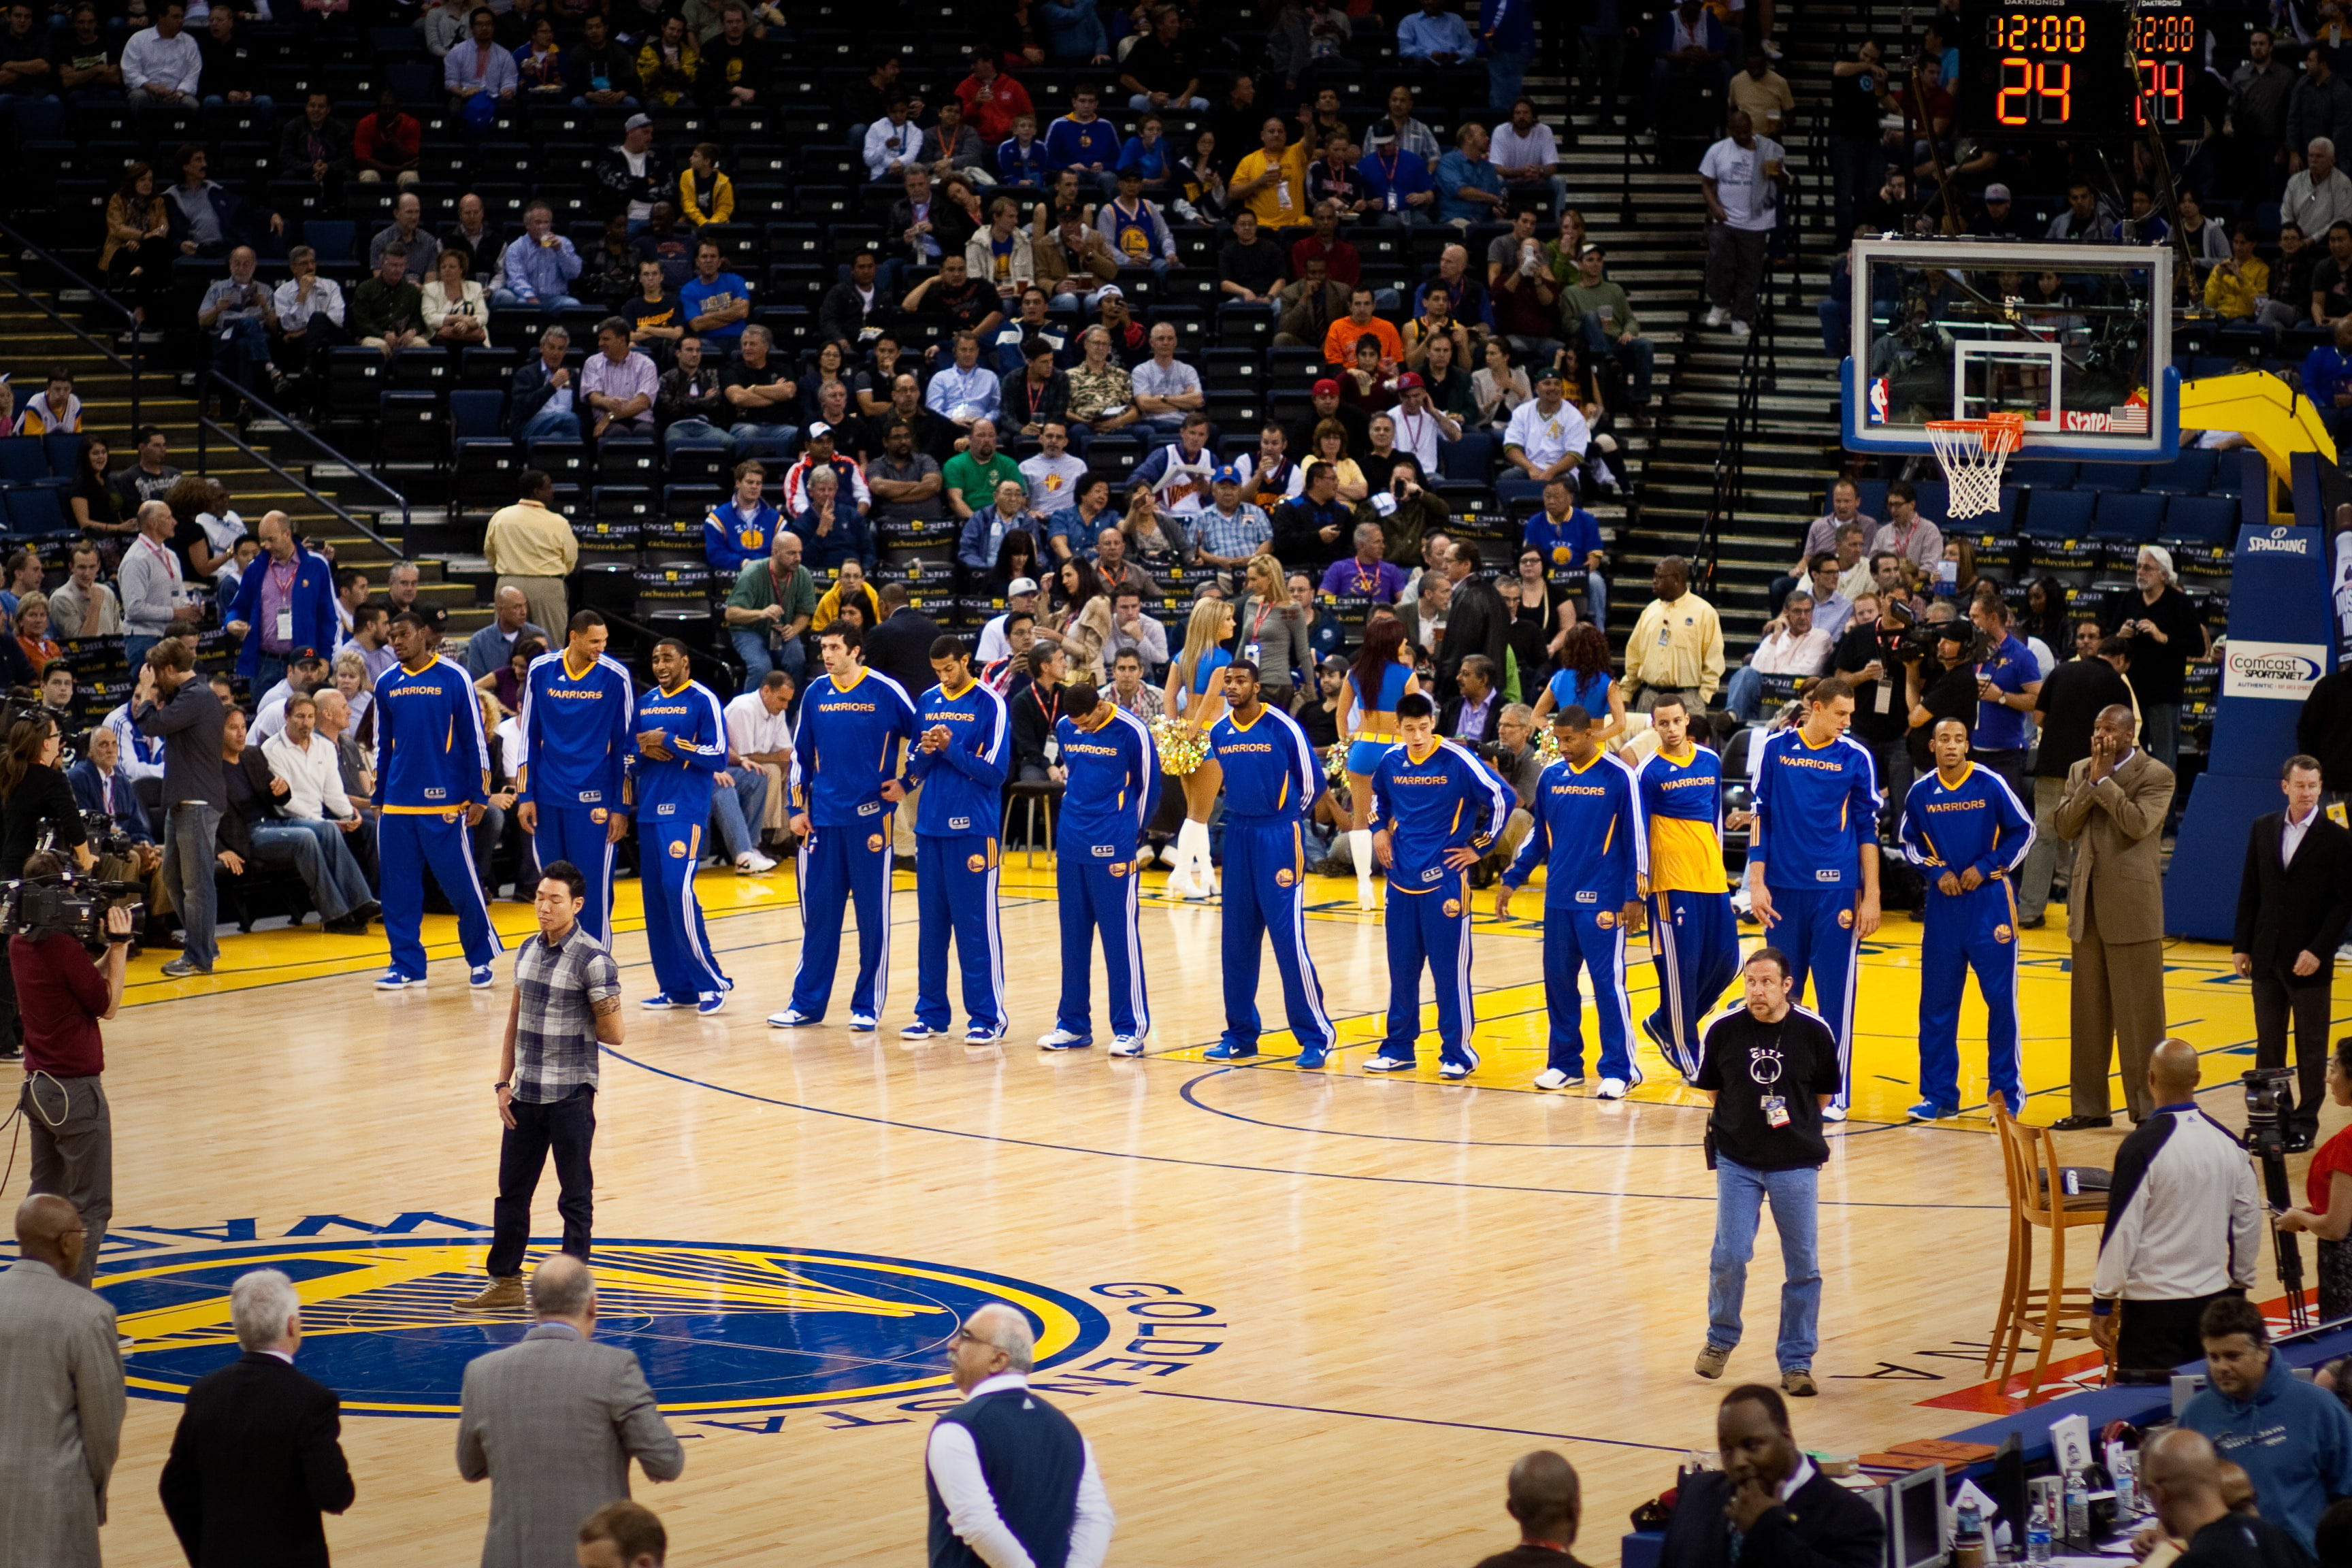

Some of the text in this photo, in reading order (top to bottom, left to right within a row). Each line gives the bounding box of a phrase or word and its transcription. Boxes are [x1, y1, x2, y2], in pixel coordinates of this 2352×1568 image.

[1997, 15, 2085, 52] 12:00
[2136, 16, 2194, 52] 12:00
[1997, 57, 2071, 125] 24
[2135, 59, 2184, 127] 24
[882, 522, 911, 531] CACHE
[887, 537, 953, 548] cachecreek.com
[2031, 538, 2102, 550] CACHE CREEK
[2248, 536, 2307, 555] SPALDING
[2031, 557, 2093, 568] cachecreek.com
[633, 570, 664, 581] CACHE
[877, 570, 906, 578] CACHE
[639, 589, 706, 598] cachecreek.com
[960, 598, 990, 607] CACHE
[2244, 669, 2304, 681] SPORTSNET
[389, 686, 442, 698] WARRIORS
[546, 687, 603, 700] WARRIORS
[640, 706, 687, 716] WARRIORS
[817, 702, 876, 713] WARRIORS
[925, 712, 975, 722] WARRIORS
[1064, 743, 1117, 756] WARRIORS
[1218, 743, 1272, 755] WARRIORS
[1779, 755, 1842, 772] WARRIORS
[1392, 775, 1448, 785] WARRIORS
[1661, 777, 1716, 791] WARRIORS
[1551, 785, 1605, 796] WARRIORS
[1925, 799, 1987, 813] WARRIORS
[1751, 1049, 1784, 1060] CITY
[1027, 1283, 1227, 1396] GOLDEN
